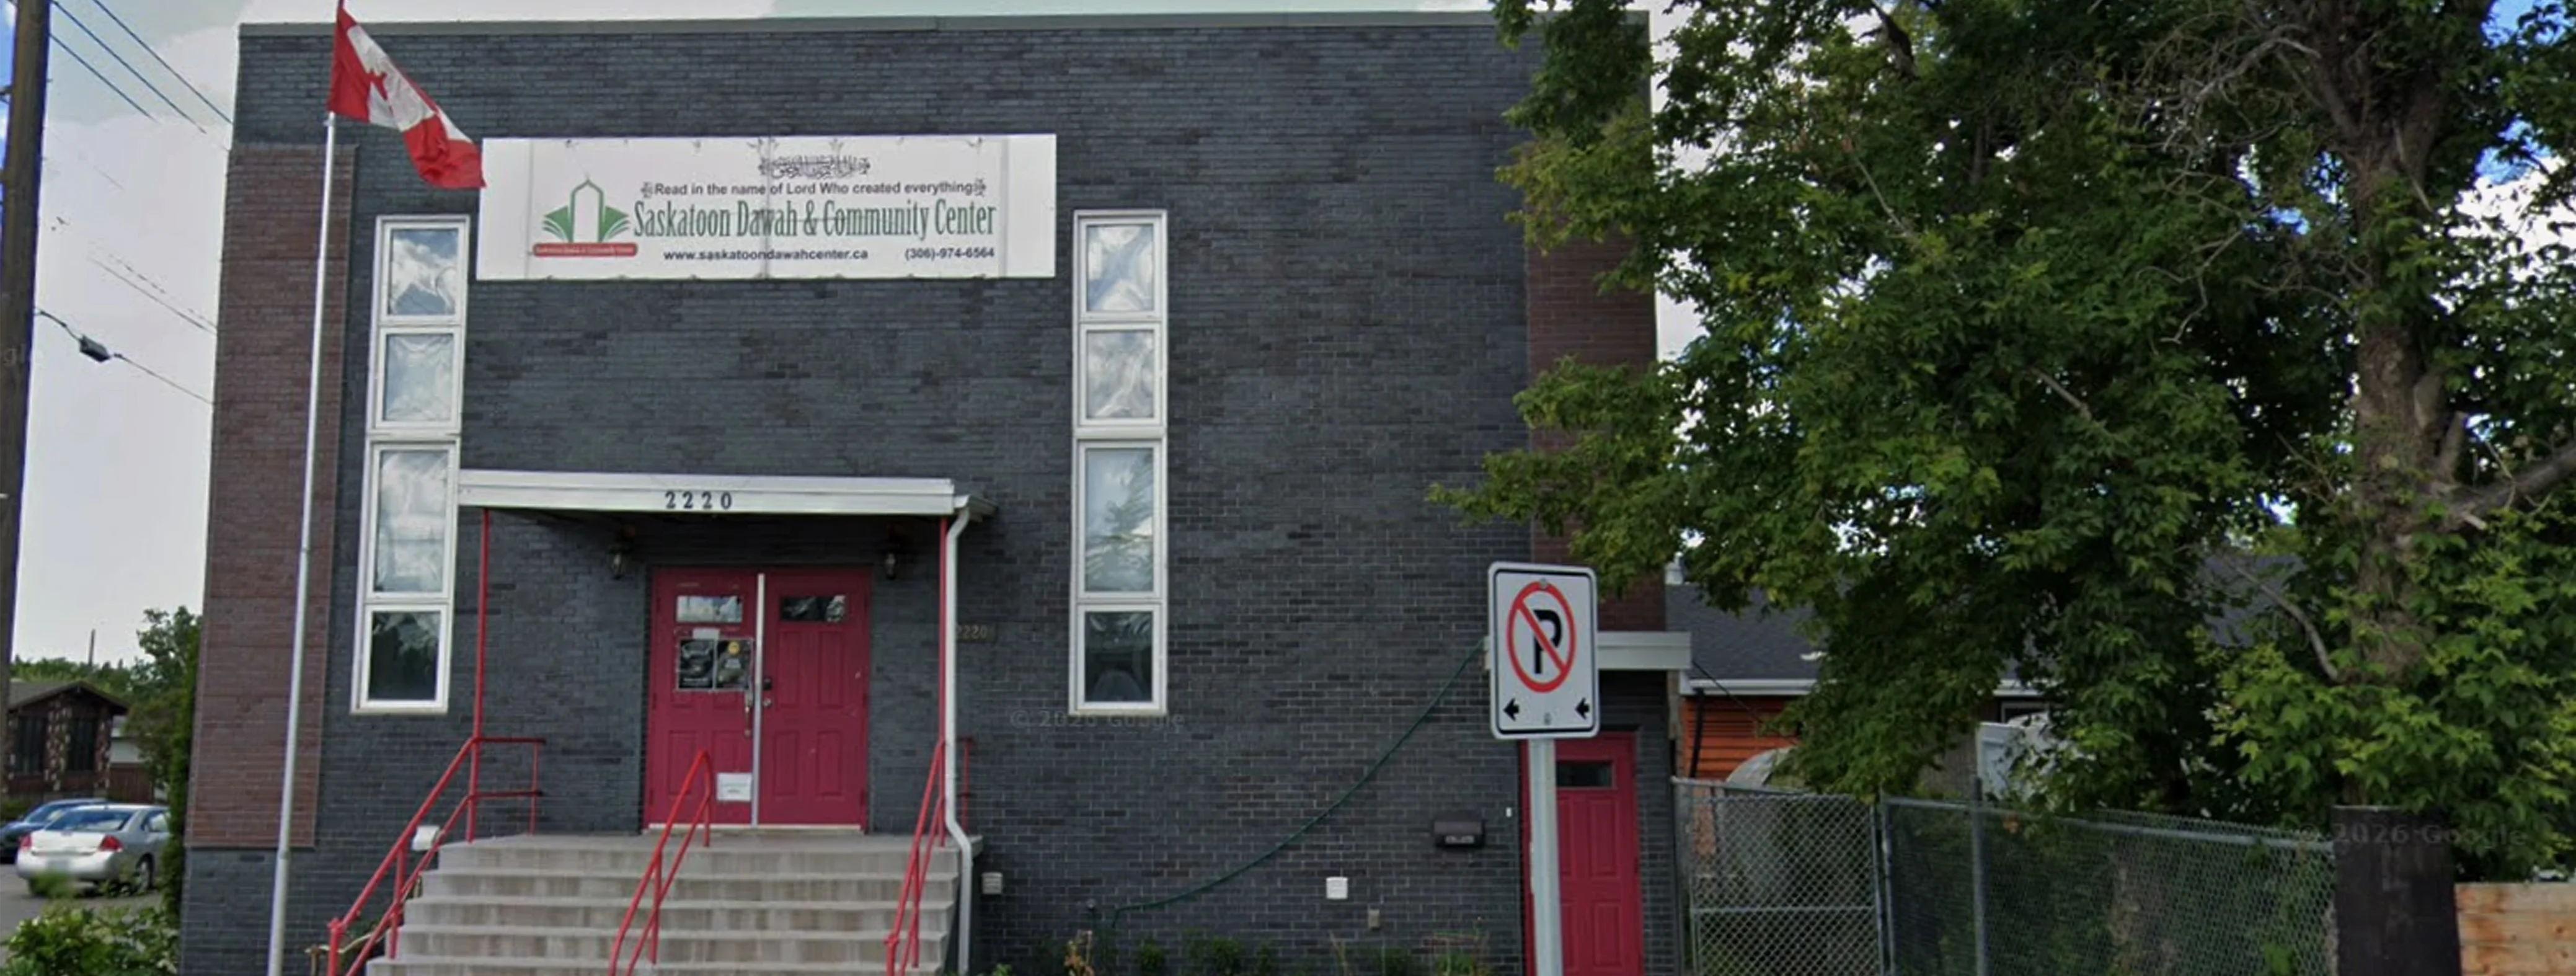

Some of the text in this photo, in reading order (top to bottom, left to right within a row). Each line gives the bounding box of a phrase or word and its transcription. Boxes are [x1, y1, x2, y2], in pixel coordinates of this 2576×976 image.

[654, 182, 973, 195] Read in the name of Lord Who created everything
[634, 198, 996, 241] Saskatoon Dawah & Community Center
[663, 247, 994, 260] www.saskatoondawahcenter.ca (306)-974-6564
[665, 490, 732, 509] 2220
[1533, 609, 1562, 674] P
